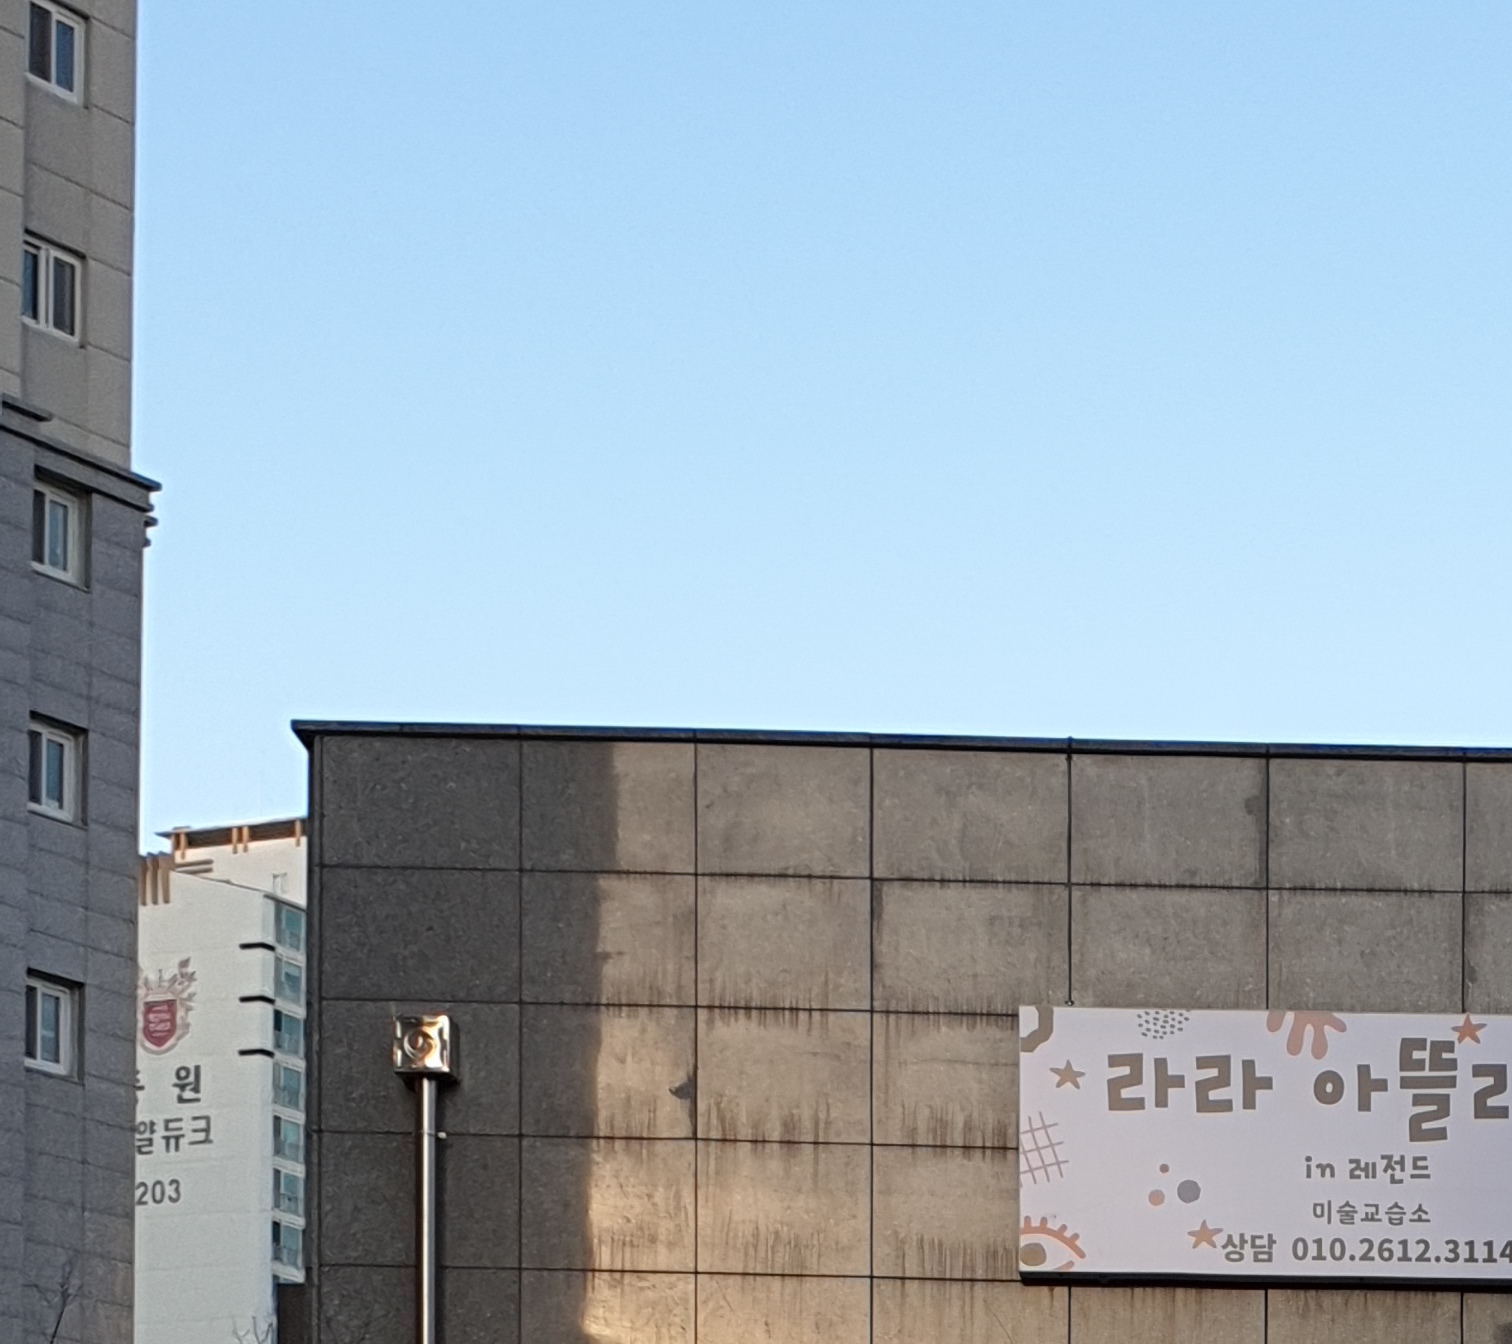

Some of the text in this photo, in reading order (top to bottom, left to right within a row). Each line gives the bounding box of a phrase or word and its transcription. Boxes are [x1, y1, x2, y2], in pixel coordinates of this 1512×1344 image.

[1106, 1052, 1273, 1114] 라라
[1304, 1154, 1432, 1184] in 레전드
[135, 1178, 181, 1206] 203
[1312, 1201, 1432, 1227] 미술교습소
[1220, 1234, 1276, 1264] 상담
